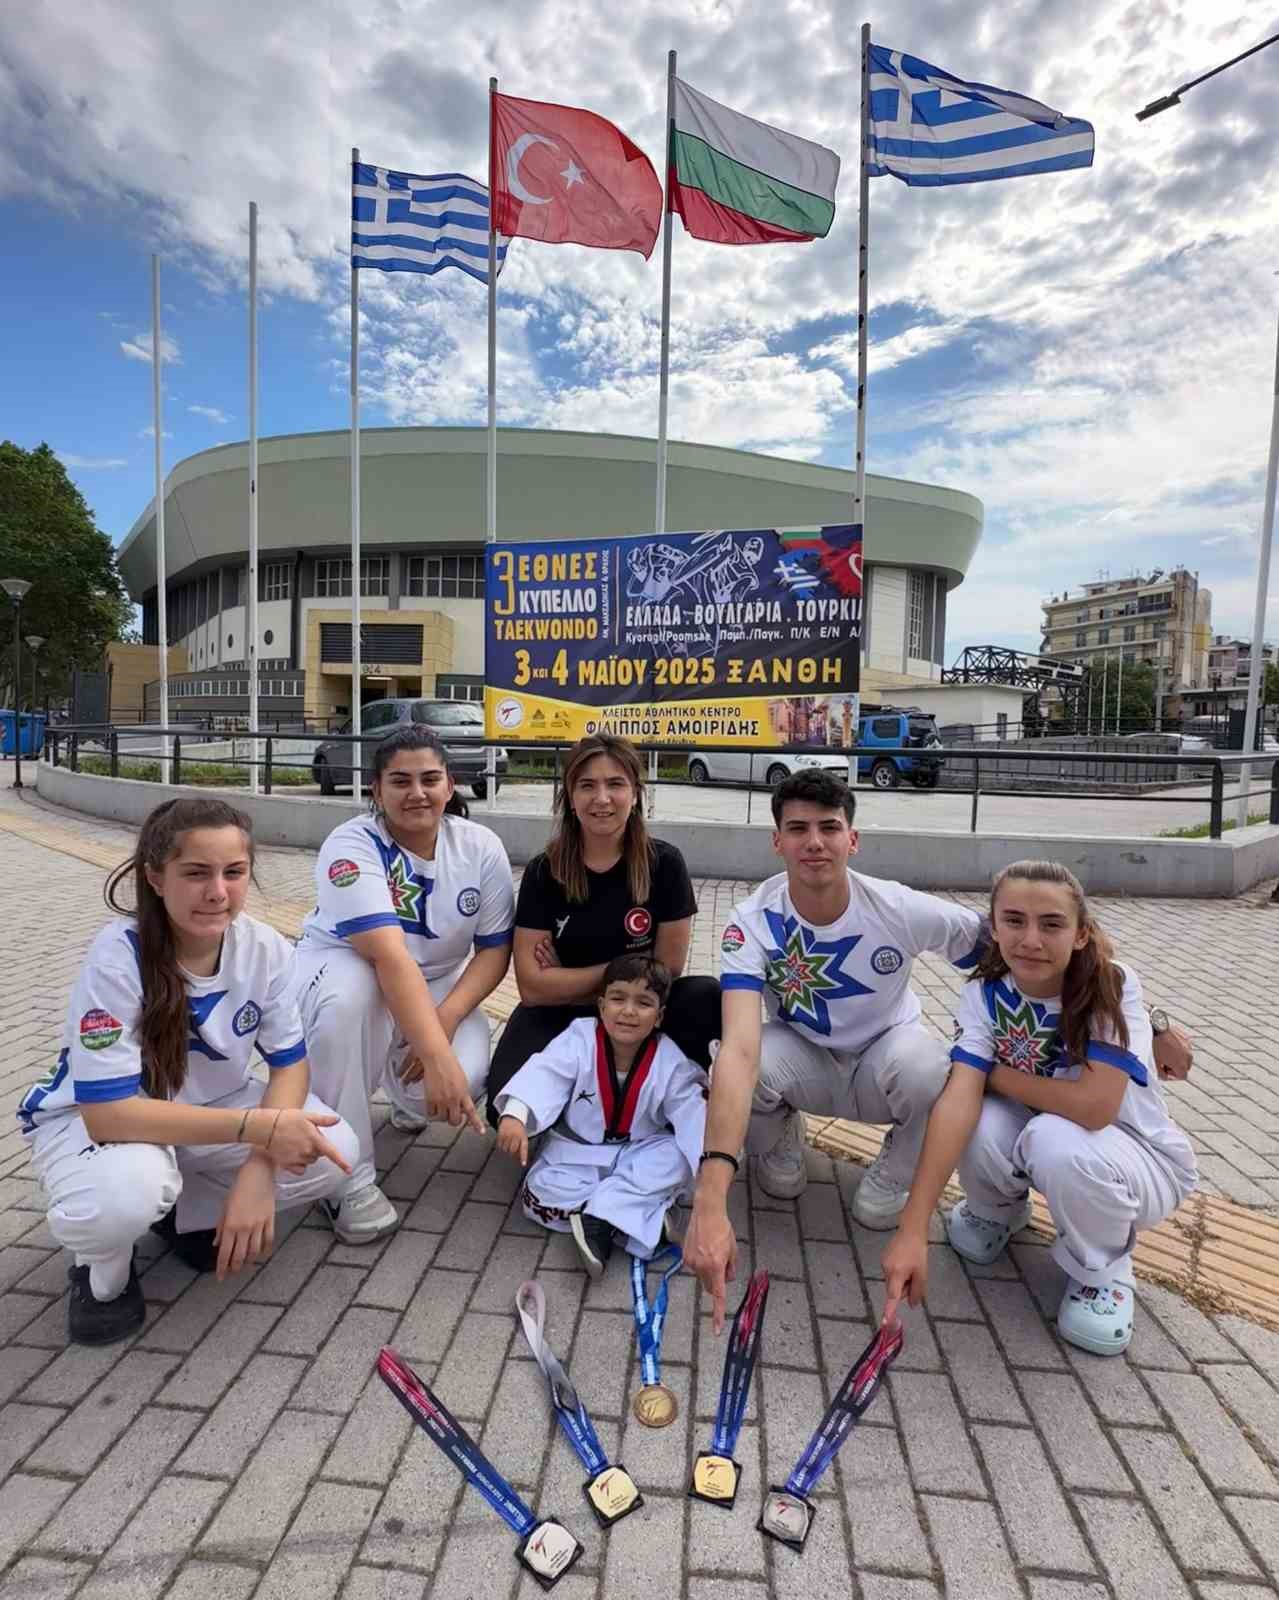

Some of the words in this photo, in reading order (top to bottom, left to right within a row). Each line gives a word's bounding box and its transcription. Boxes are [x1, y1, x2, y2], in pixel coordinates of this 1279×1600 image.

[494, 551, 515, 614] 3
[518, 552, 597, 581] ΕΘΝΕΣ
[519, 588, 597, 613] ΚΥΠΕΛΛΟ
[625, 604, 681, 627] ΕΛΛΑΔΑ
[694, 600, 782, 625] ΒΟΥΛΓΑΡΙΑ
[494, 618, 598, 640] TAEKWONDO
[513, 648, 530, 686] 3
[551, 648, 568, 686] 4
[578, 655, 647, 686] ΜΑΪΟΥ
[654, 657, 716, 685] 2025
[726, 657, 842, 684] ΞΑΝΘΗ
[602, 707, 641, 718] ΚΛΕΙΣΤΟ
[645, 706, 696, 718] ΑΘΛΗΤΙΚΟ
[700, 706, 742, 717] ΚΕΝΤΡΟ
[666, 720, 759, 736] ΑΜΟΙΡΙΔΗΣ
